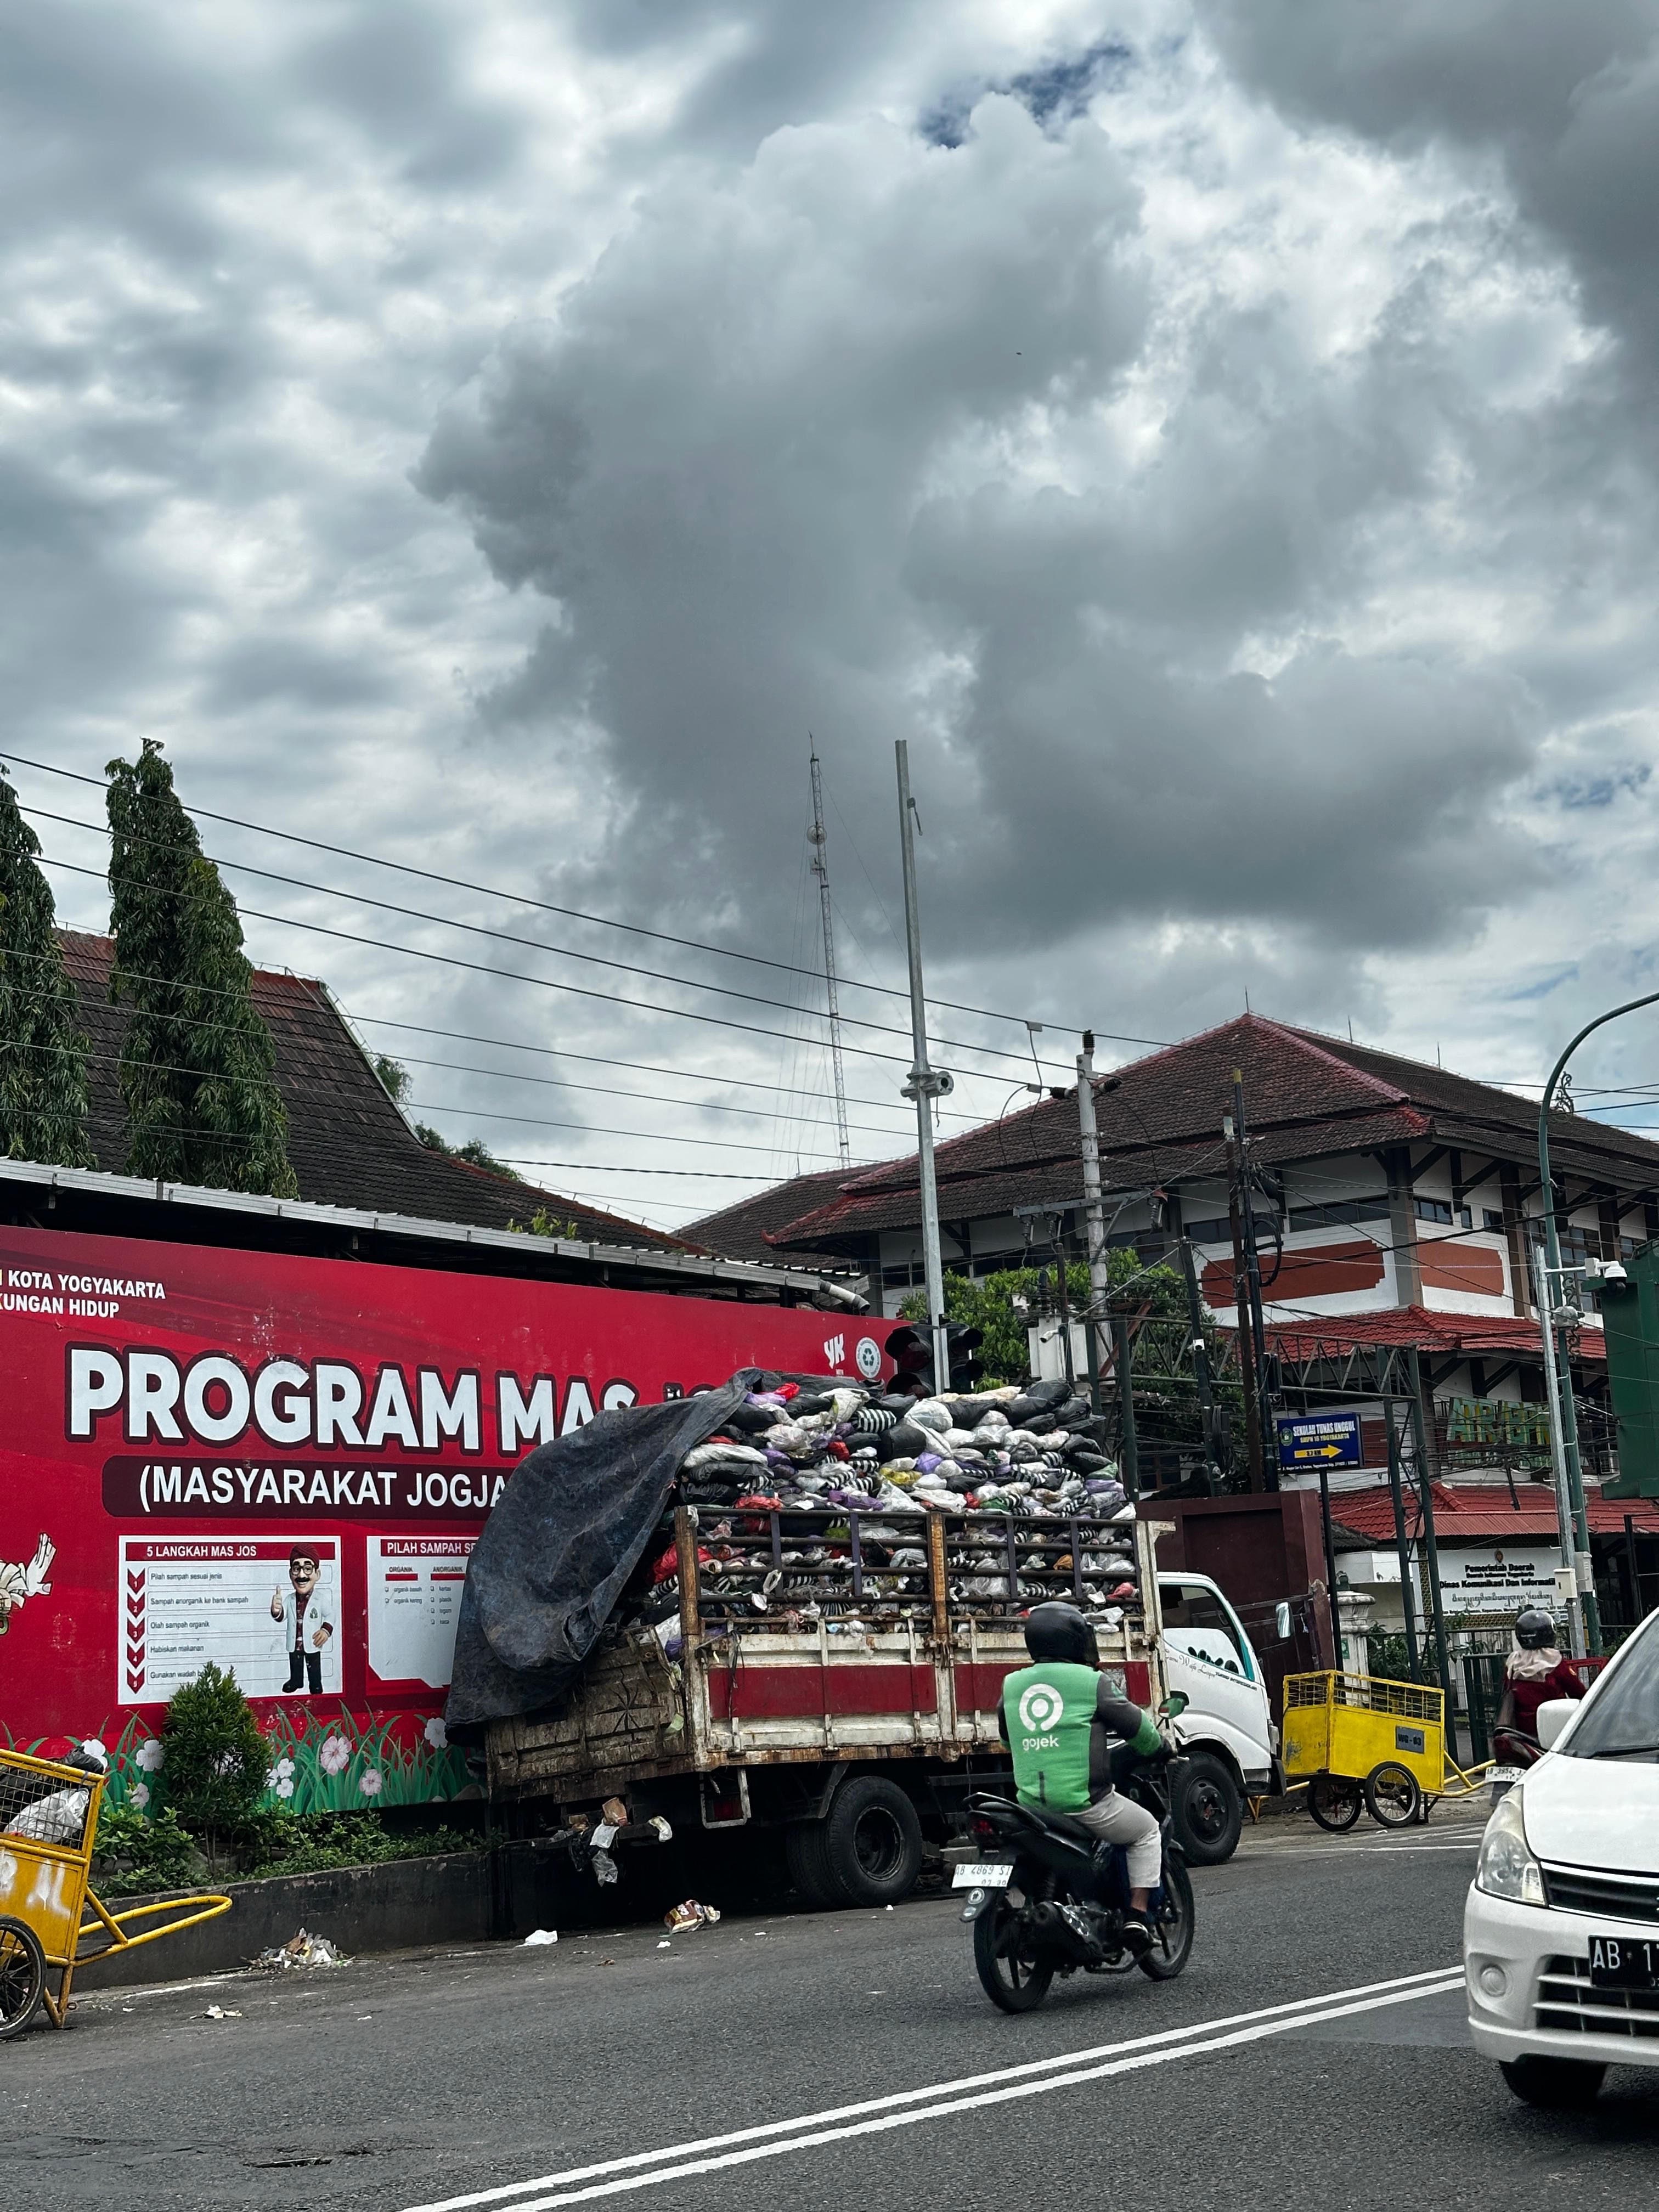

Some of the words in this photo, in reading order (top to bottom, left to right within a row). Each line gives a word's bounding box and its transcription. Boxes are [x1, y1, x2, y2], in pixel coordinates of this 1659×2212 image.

[8, 1270, 53, 1290] KOTA
[58, 1274, 166, 1299] YOGYAKARTA
[0, 1293, 64, 1314] UNGAN
[69, 1299, 119, 1318] HIDUP
[71, 1348, 479, 1449] PROGRAM
[140, 1465, 397, 1512] (MASYARAKAT
[146, 1546, 153, 1557] 5
[156, 1546, 208, 1557] LANGKAH
[211, 1546, 234, 1557] MAS
[236, 1545, 257, 1556] JOS
[387, 1542, 417, 1554] PILAH
[420, 1543, 461, 1554] SAMPAH
[1465, 1564, 1507, 1572] Pemerintah
[1462, 1578, 1504, 1588] Komunikasi
[150, 1598, 174, 1606] Sampah
[176, 1597, 202, 1605] anorganik
[166, 1622, 188, 1630] sampah
[189, 1621, 210, 1629] organik
[1022, 1734, 1059, 1751] gojek
[955, 1865, 966, 1876] AB
[971, 1865, 995, 1875] 4869
[1593, 1939, 1620, 1969] AB
